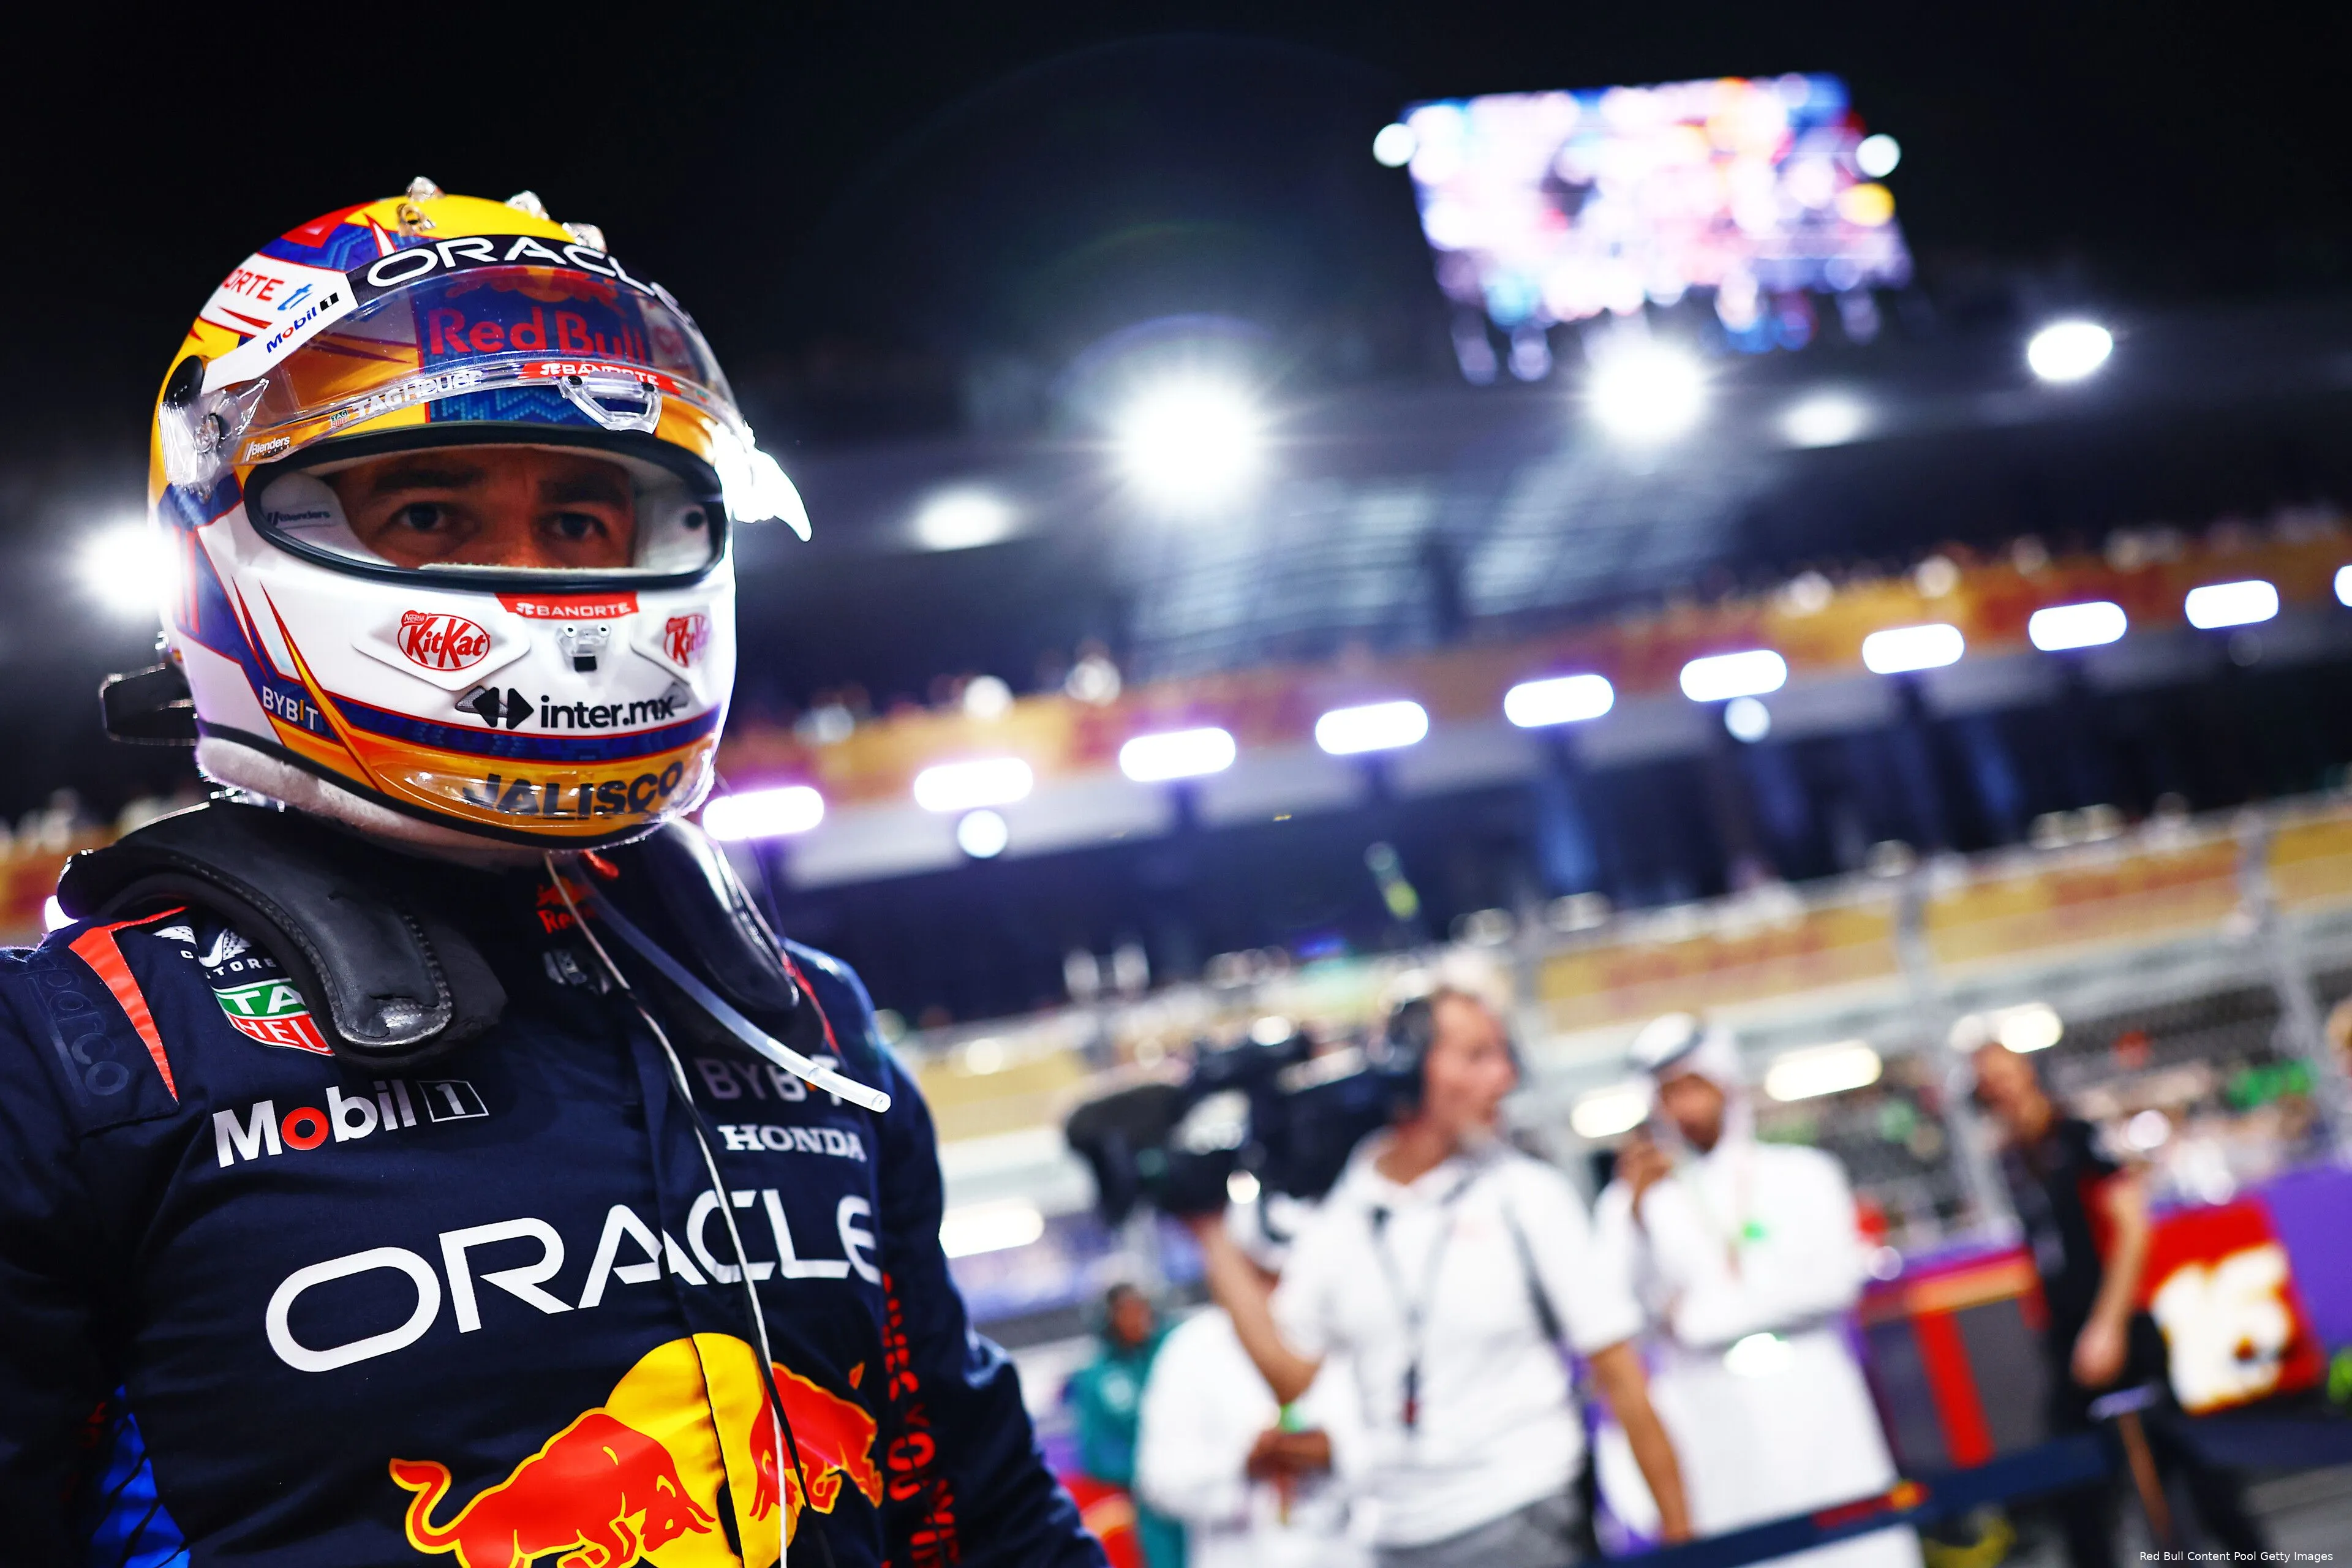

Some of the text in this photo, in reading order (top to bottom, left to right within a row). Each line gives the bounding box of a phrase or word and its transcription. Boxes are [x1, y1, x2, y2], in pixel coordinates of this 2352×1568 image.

[266, 306, 317, 353] Mobil
[430, 307, 545, 355] Red
[555, 310, 647, 368] Bull
[252, 436, 291, 456] Blenders
[537, 603, 631, 617] BANORTE
[407, 617, 486, 668] KitKat
[262, 686, 318, 731] BYBIT
[541, 695, 675, 729] inter.mx
[462, 761, 684, 818] JALISCO
[180, 949, 276, 979] CTORE
[698, 1054, 843, 1106] BYBT
[213, 1078, 418, 1167] Mobil
[717, 1125, 867, 1163] HONDA
[266, 1187, 883, 1372] ORACLE
